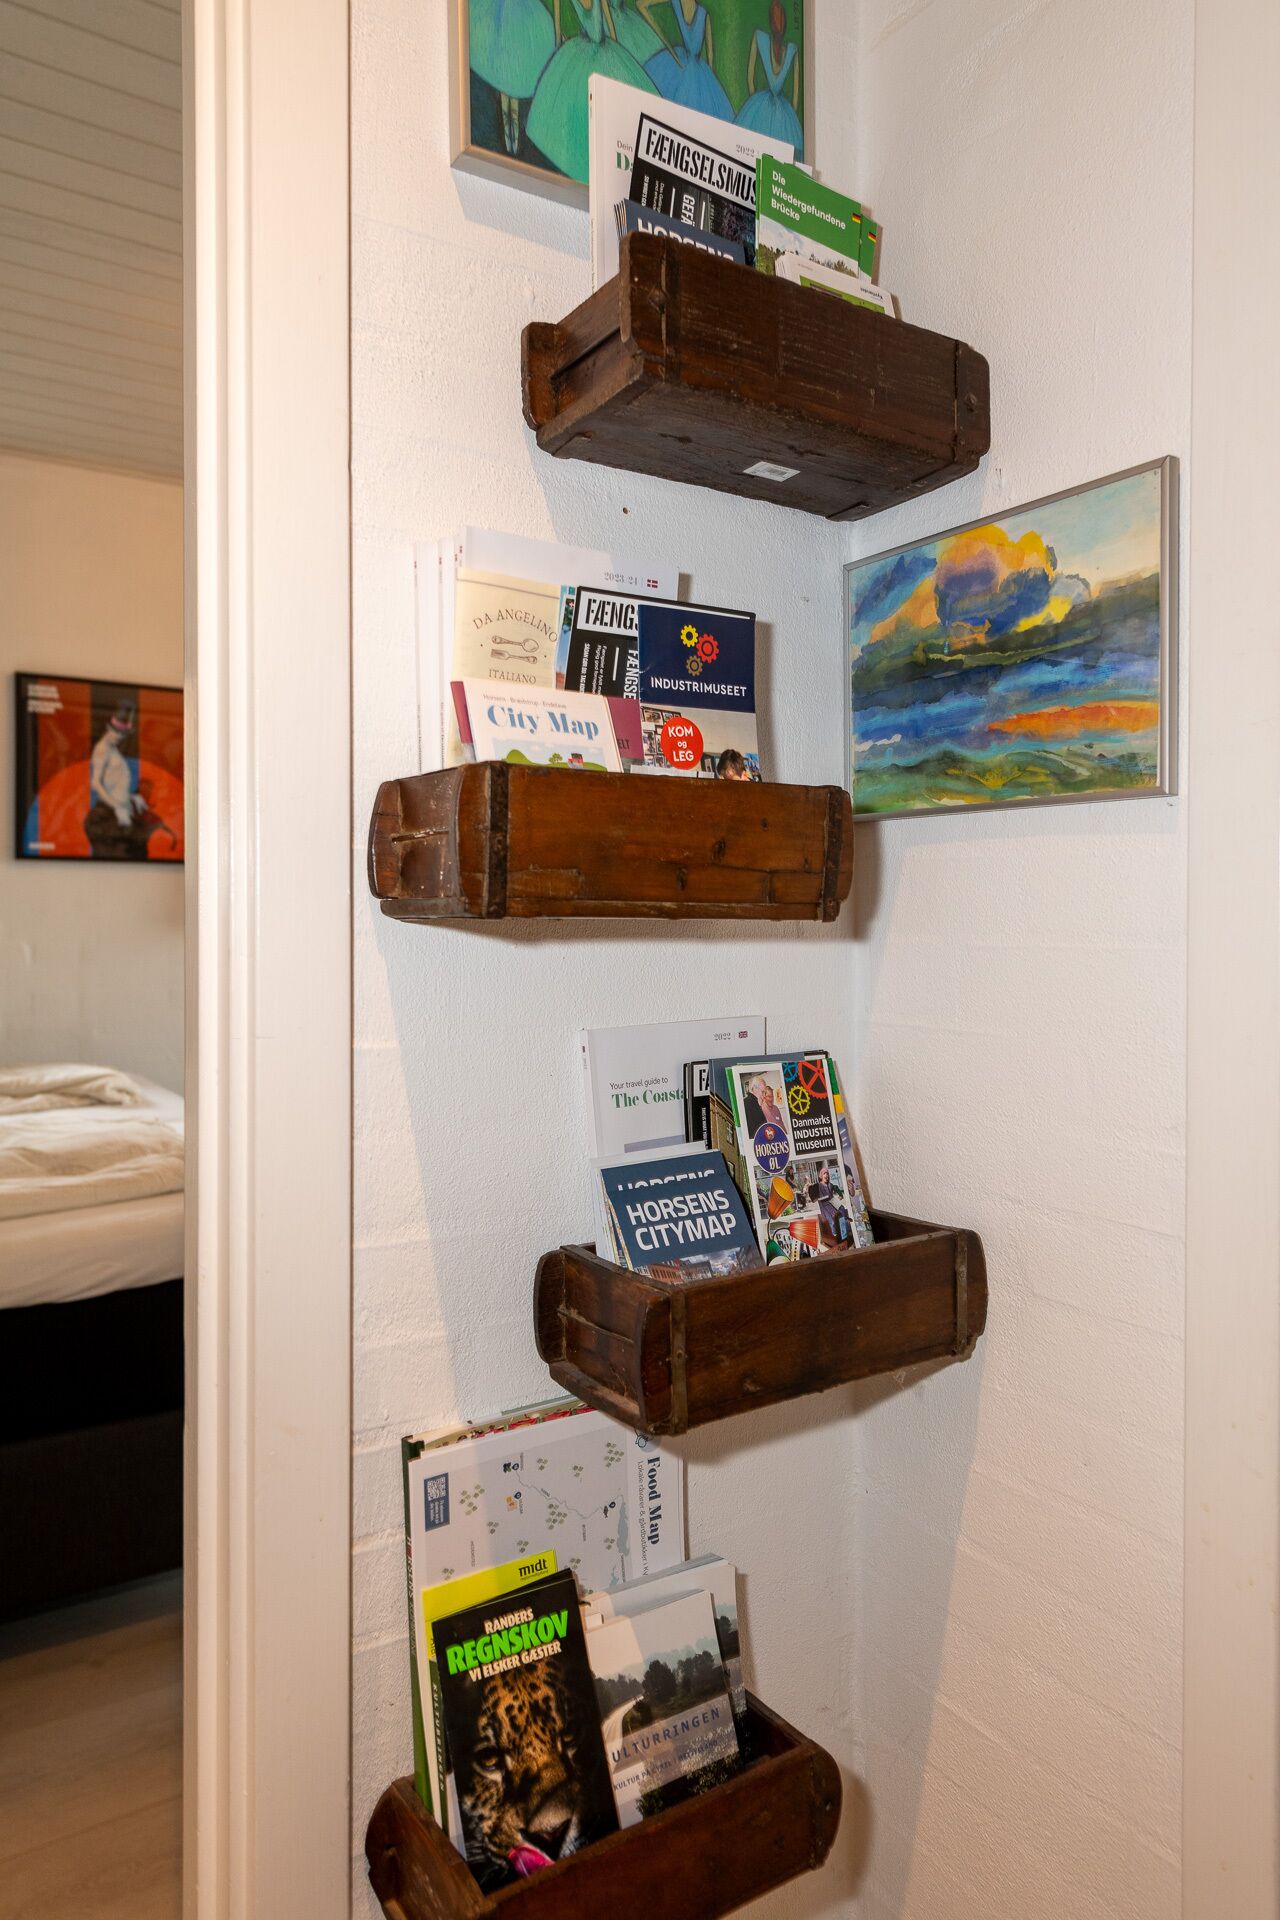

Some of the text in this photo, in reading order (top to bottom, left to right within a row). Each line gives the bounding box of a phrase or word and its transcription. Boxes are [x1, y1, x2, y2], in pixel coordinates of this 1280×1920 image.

[616, 140, 633, 153] Dein
[736, 144, 755, 158] 2022
[616, 151, 633, 173] D
[772, 170, 786, 186] Die
[771, 184, 846, 231] Wiedergefundene
[771, 199, 801, 222] Brücke
[585, 598, 638, 632] FÆNG
[473, 608, 558, 643] DA ANGELINO
[488, 669, 537, 685] ITALIANO
[650, 676, 747, 697] INDUSTRIMUSEET
[487, 704, 599, 741] City Map
[668, 726, 694, 738] KOM
[677, 741, 687, 749] og
[672, 750, 694, 762] LEG
[713, 1032, 731, 1041] 2022
[609, 1081, 624, 1090] Your
[625, 1078, 643, 1088] travel
[644, 1077, 660, 1088] guide
[611, 1092, 639, 1108] The
[792, 1115, 831, 1128] Danmarks
[794, 1126, 833, 1140] INDUSTRI
[755, 1141, 790, 1158] HORSENS
[795, 1138, 834, 1151] museum
[768, 1157, 781, 1170] ØL
[625, 1189, 730, 1226] HORSENS
[635, 1212, 737, 1251] CITYMAP
[647, 1456, 662, 1545] Food Map
[518, 1558, 549, 1577] midt
[483, 1606, 534, 1635] RANDERS
[445, 1609, 568, 1676] REGNSKOV
[468, 1640, 562, 1682] VI ELSKER GÆSTER
[611, 1707, 721, 1763] ULTURRINGEN
[614, 1774, 640, 1792] KULTUR
